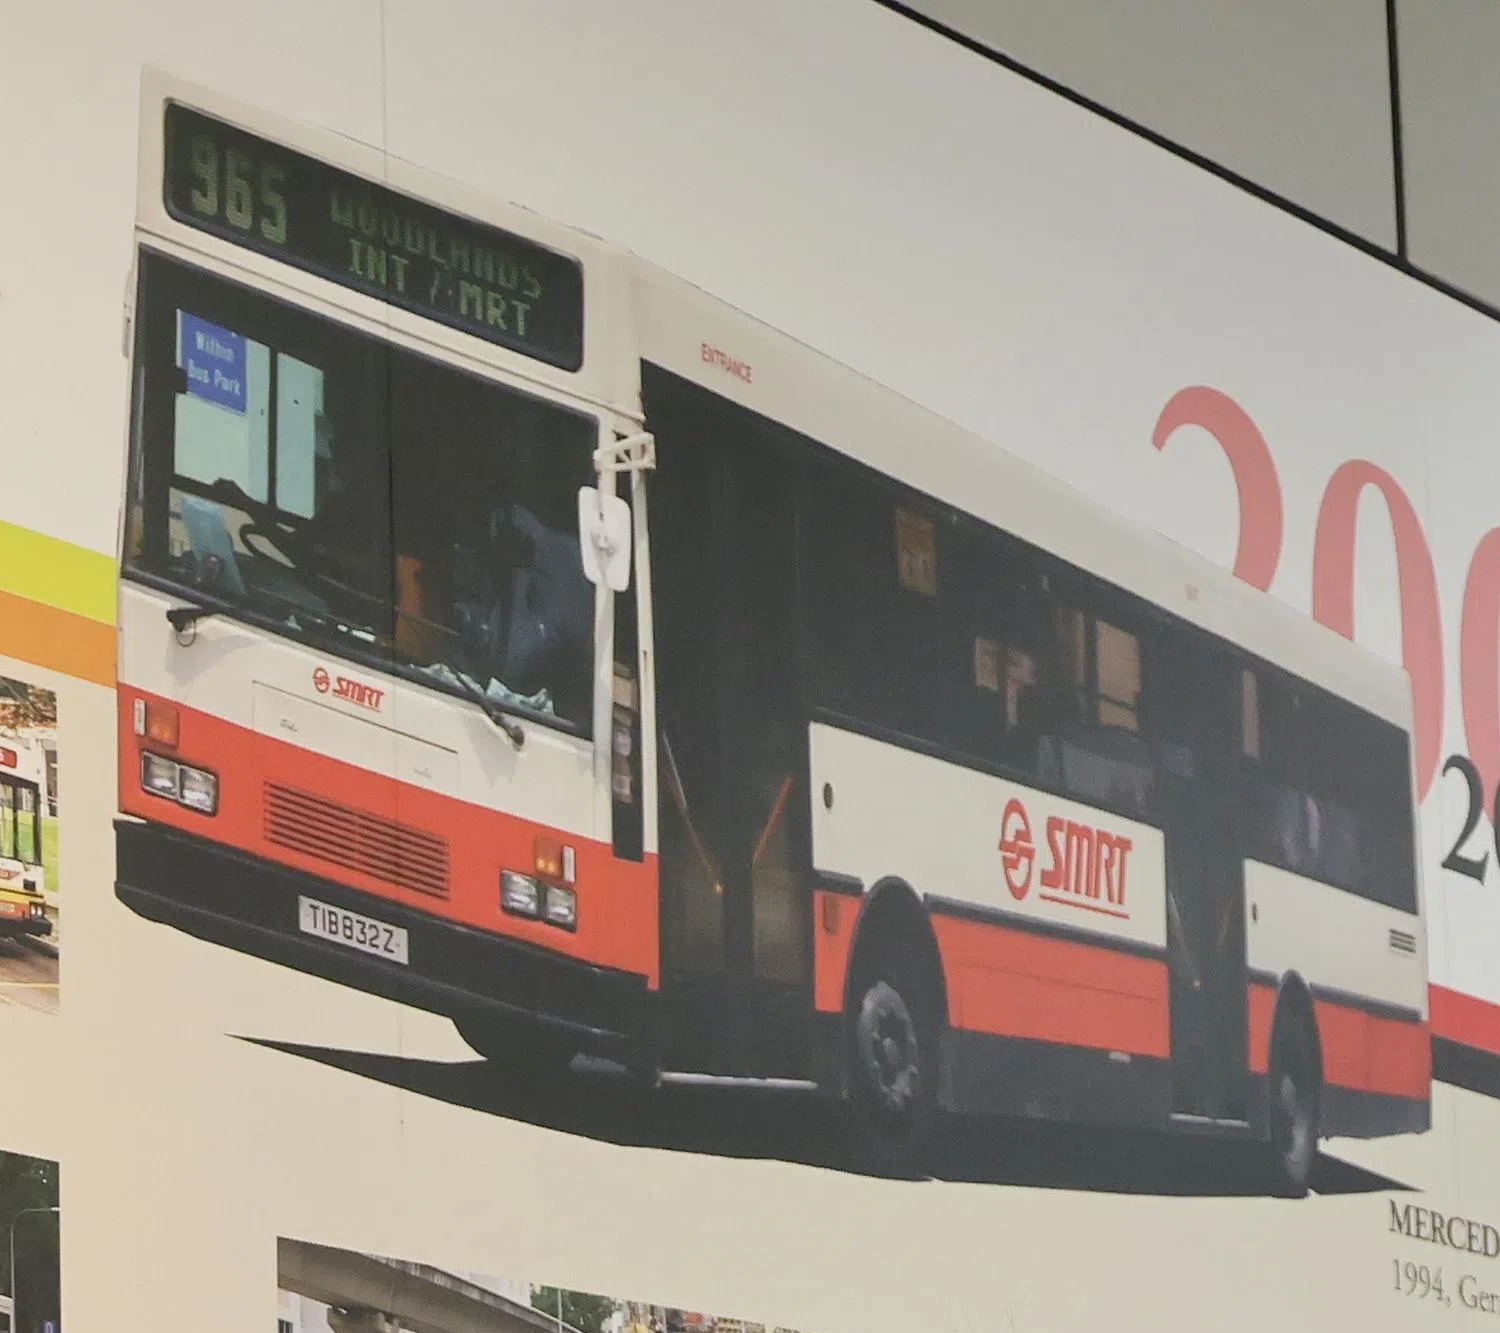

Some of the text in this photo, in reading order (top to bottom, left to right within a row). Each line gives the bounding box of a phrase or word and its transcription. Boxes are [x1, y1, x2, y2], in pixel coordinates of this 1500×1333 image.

[190, 134, 289, 245] 965
[347, 239, 532, 337] INT MRT
[332, 675, 385, 712] SMRT
[1040, 815, 1133, 907] SMRT
[308, 902, 397, 955] TIB832Z
[1391, 1257, 1454, 1309] 1994,
